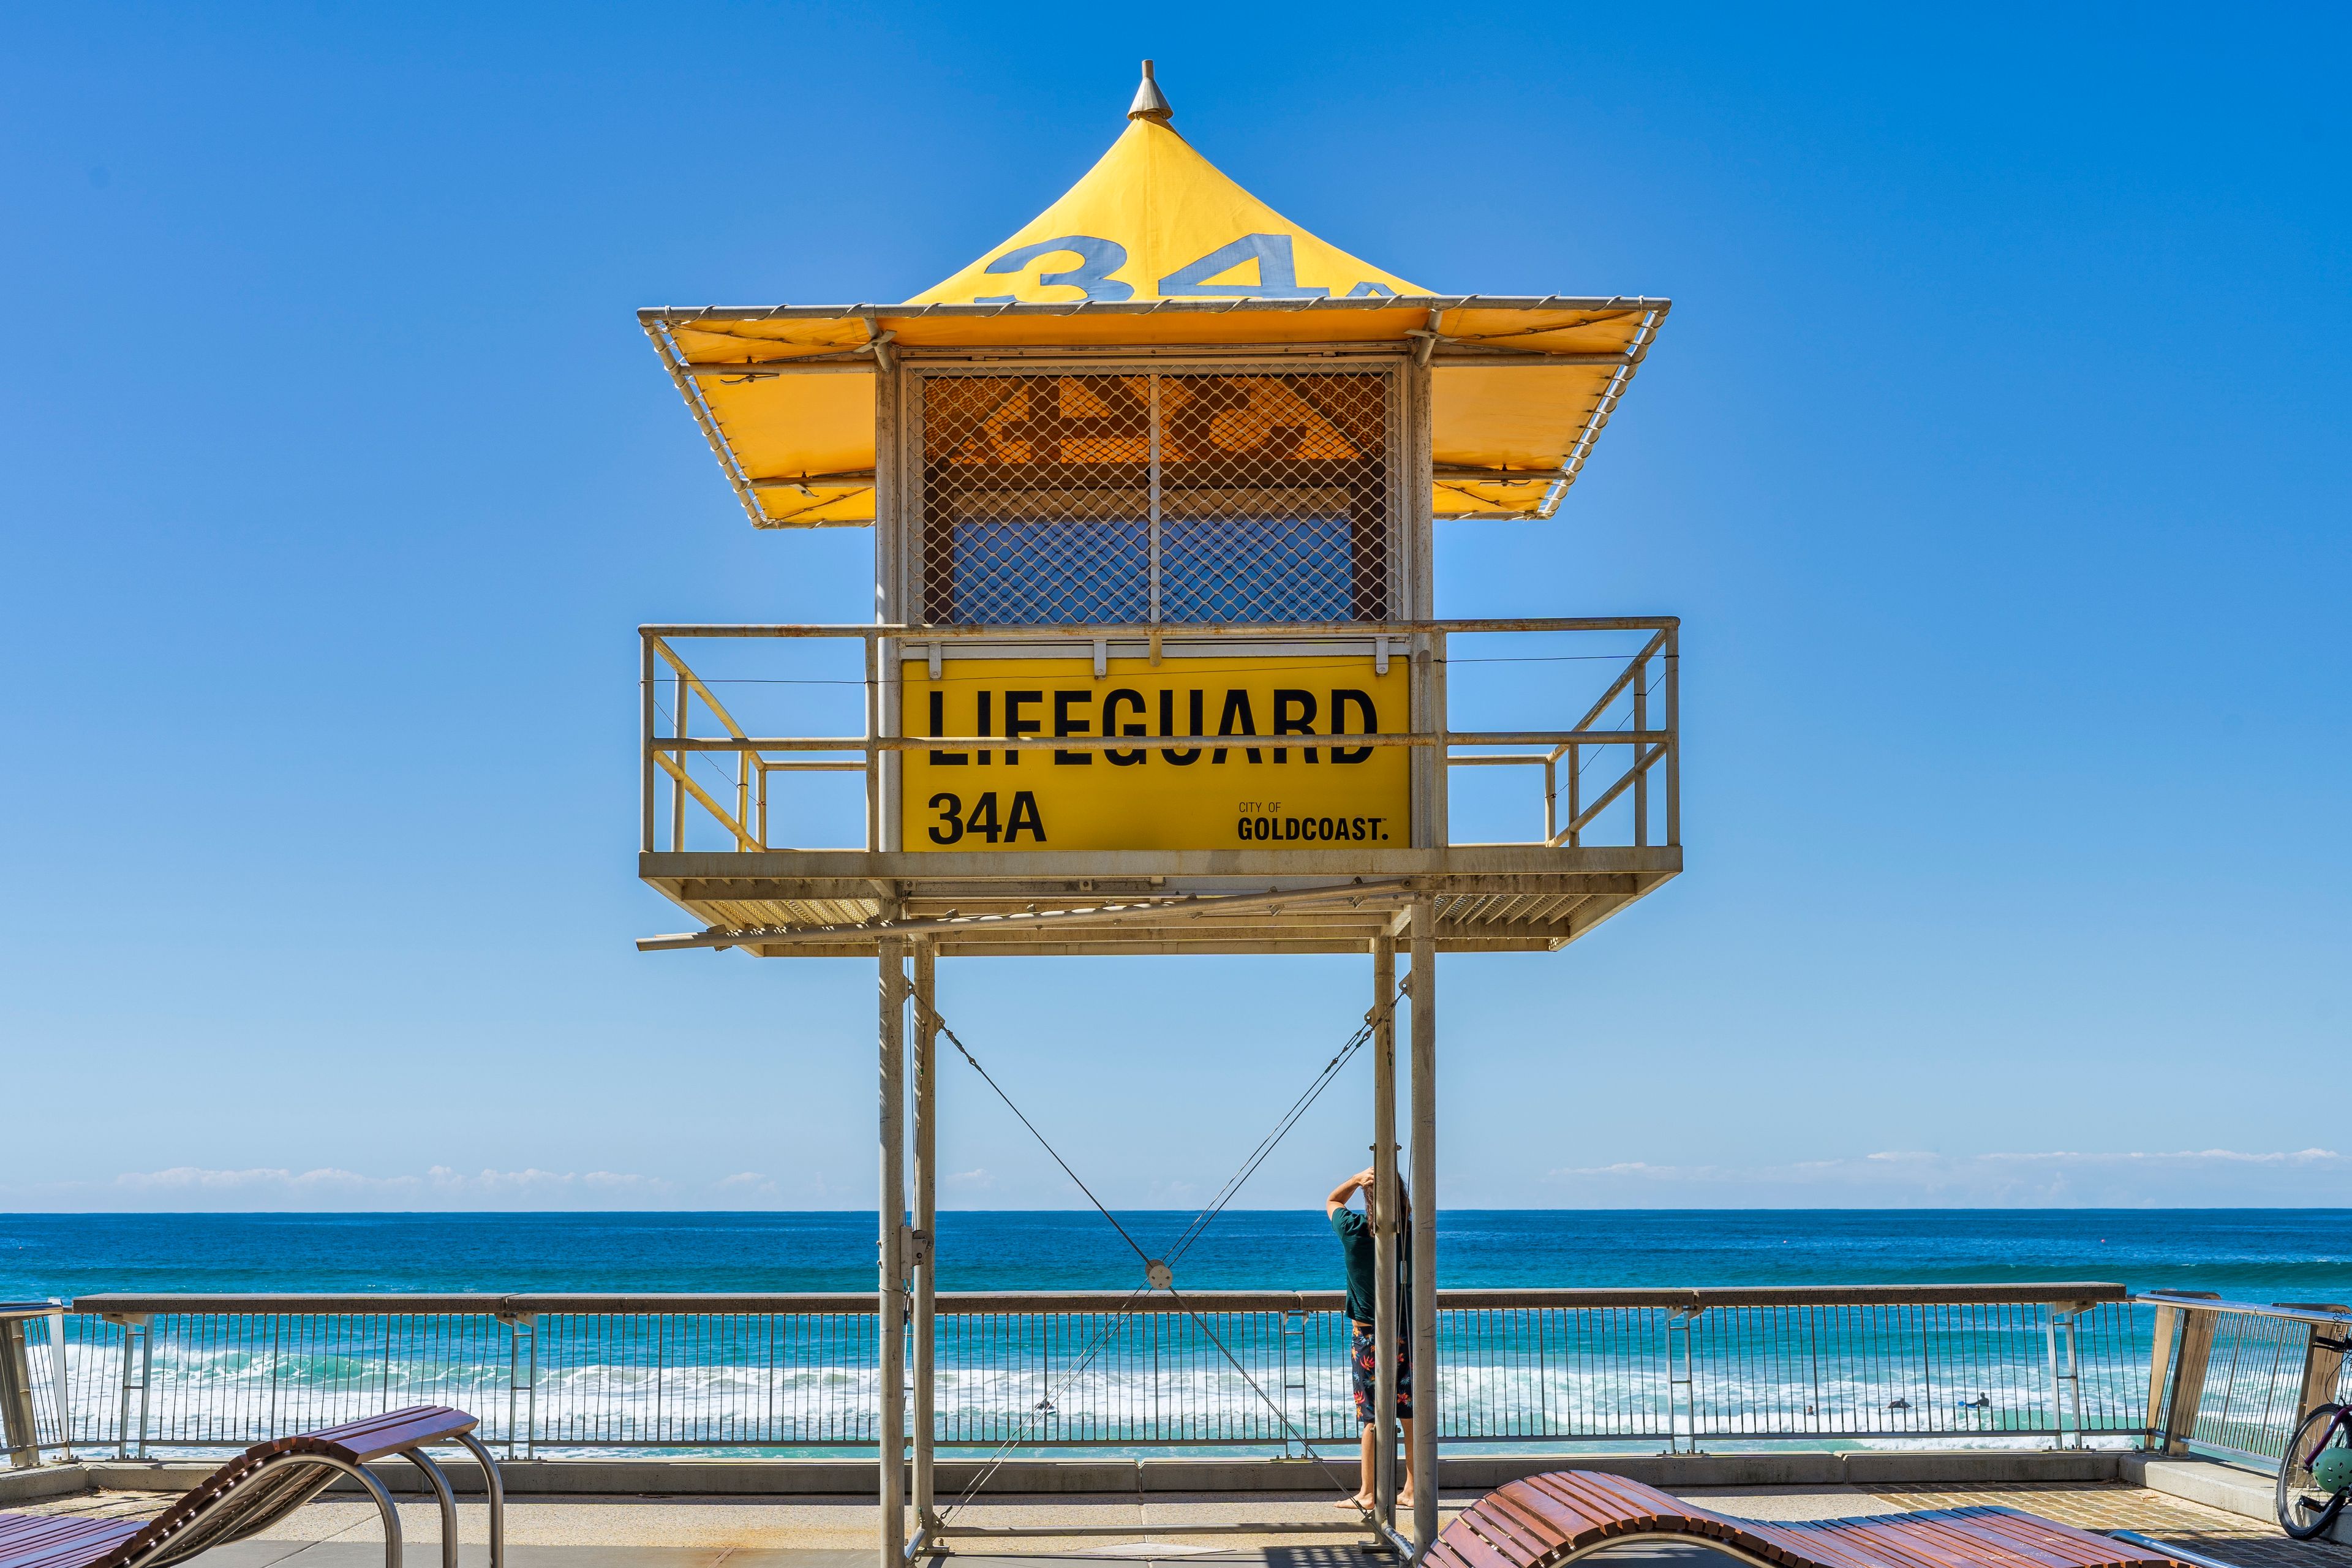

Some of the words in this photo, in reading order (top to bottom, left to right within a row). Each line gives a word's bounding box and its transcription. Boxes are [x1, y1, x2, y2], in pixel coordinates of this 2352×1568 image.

[929, 688, 1378, 767] LIFEGUARD
[928, 790, 1047, 845] 34A
[1238, 802, 1262, 813] CITY
[1268, 802, 1281, 813] OF
